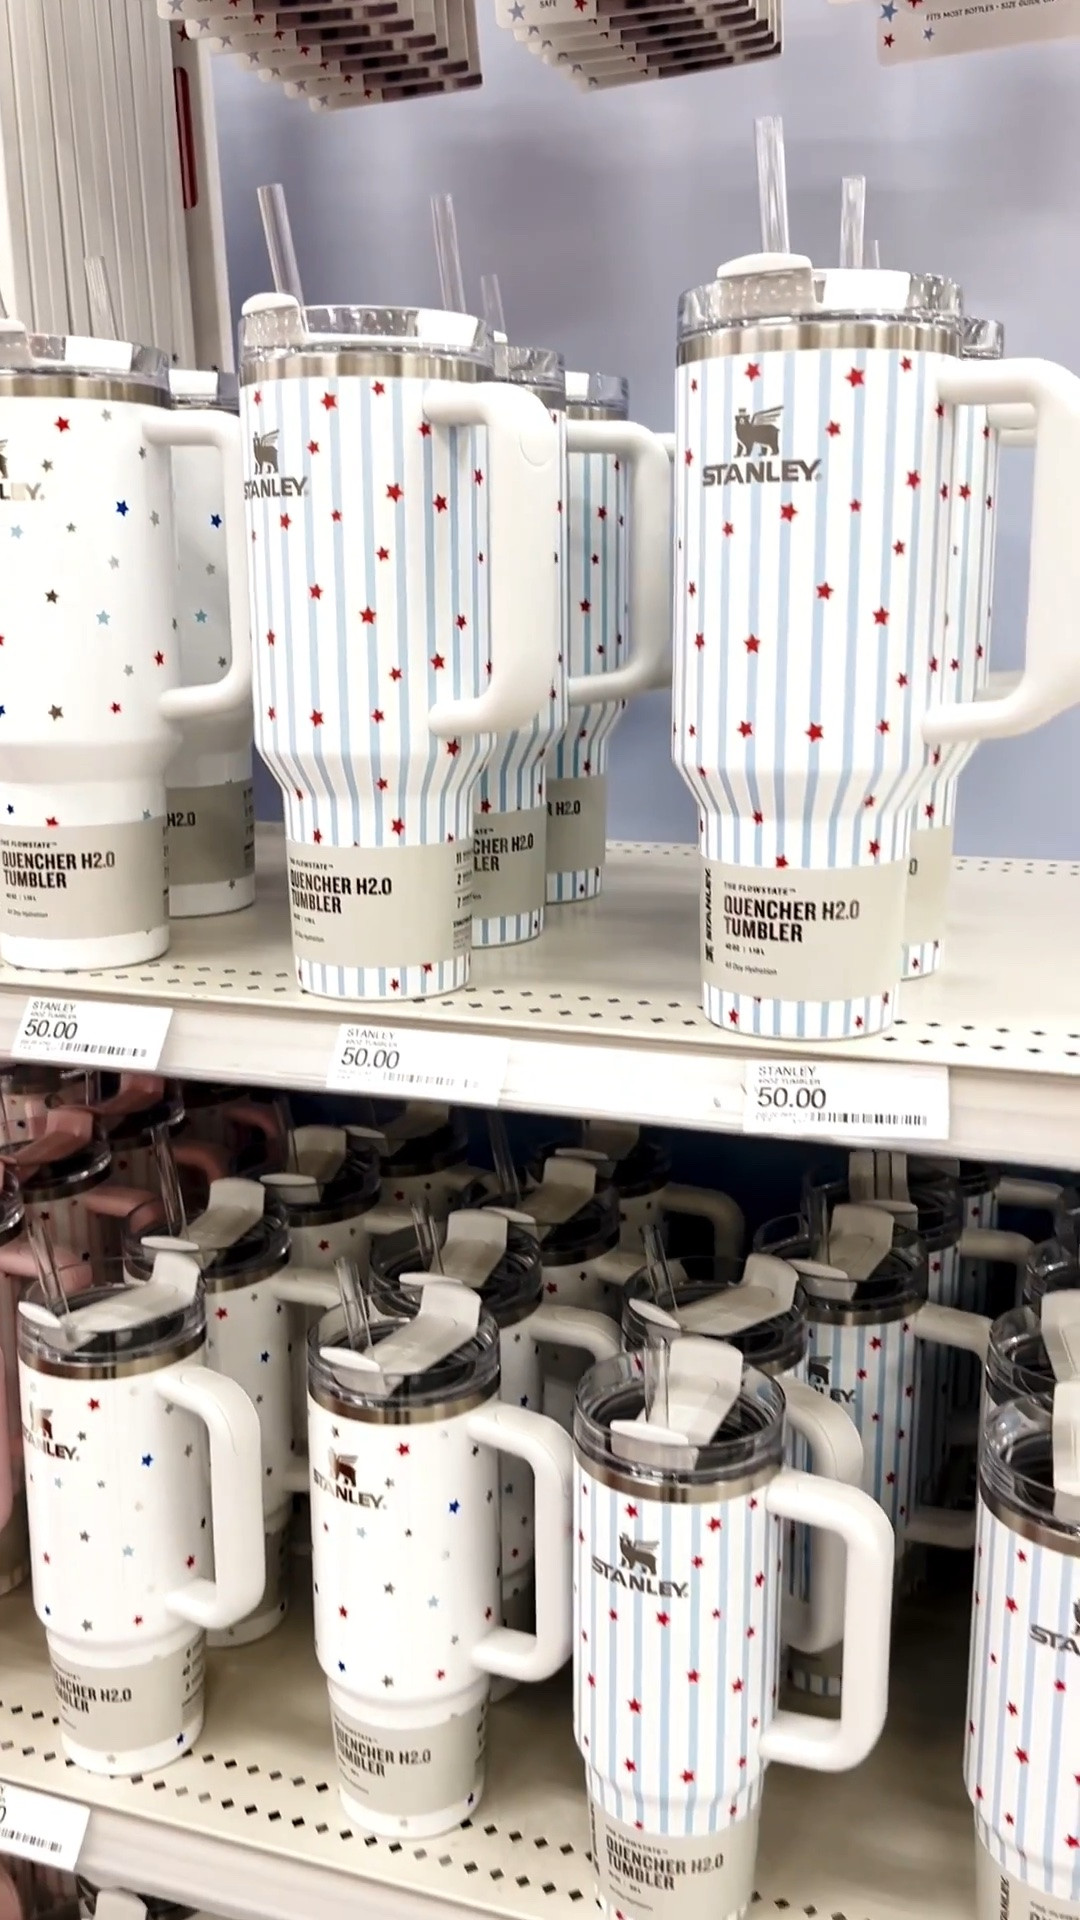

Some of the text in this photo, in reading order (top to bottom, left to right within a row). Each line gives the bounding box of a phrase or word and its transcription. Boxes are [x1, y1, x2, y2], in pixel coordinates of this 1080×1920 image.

[926, 13, 941, 21] FITS
[943, 9, 963, 18] MOST
[964, 5, 994, 16] BOTTLES
[1001, 1, 1017, 9] SIZE
[702, 459, 822, 487] STANLEY
[244, 476, 308, 500] STANLEY
[556, 800, 581, 816] H2.0
[511, 833, 534, 852] H2.0
[2, 850, 116, 870] QUENCHER H2.0
[3, 869, 67, 889] TUMBLER
[290, 868, 392, 896] QUENCHER H2.0
[291, 887, 342, 914] TUMBLER
[724, 895, 860, 921] QUENCHER H2.0
[724, 916, 803, 943] TUMBLER
[32, 1001, 76, 1013] STANLEY
[24, 1018, 78, 1040] 50.00
[347, 1028, 395, 1041] STANLEY
[341, 1046, 400, 1070] 50.00
[758, 1065, 817, 1077] STANLEY
[757, 1086, 826, 1109] 50.00
[592, 1554, 688, 1598] STANLEY
[606, 1833, 724, 1876] QUENCHER H2.0
[606, 1850, 675, 1891] TUMBLER
